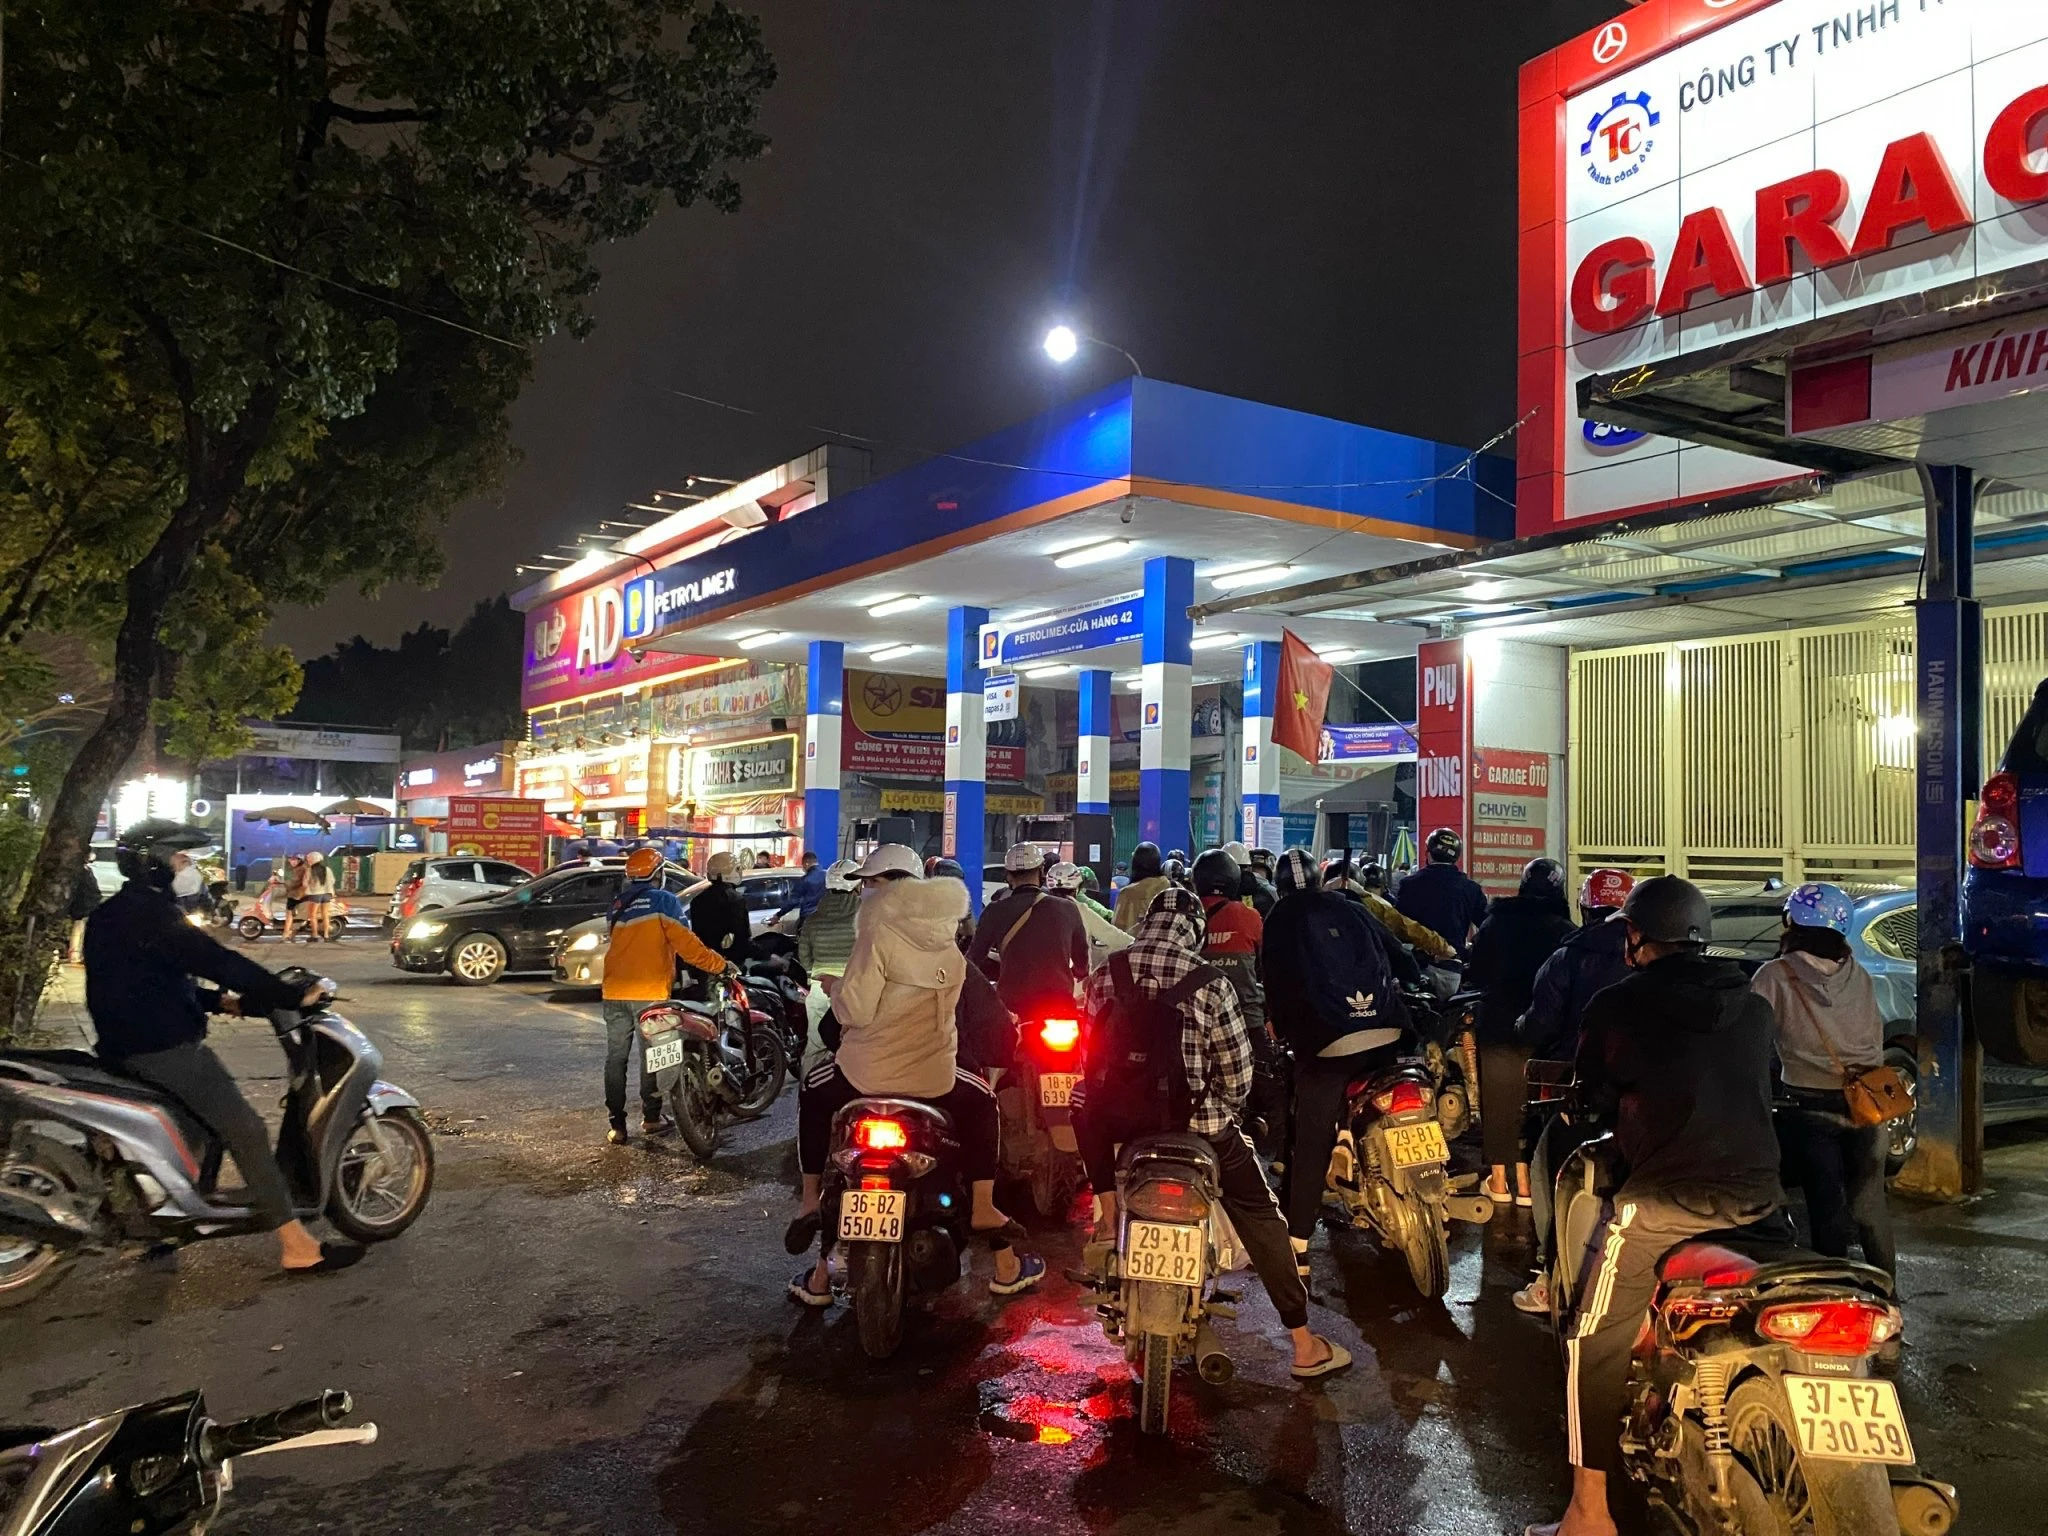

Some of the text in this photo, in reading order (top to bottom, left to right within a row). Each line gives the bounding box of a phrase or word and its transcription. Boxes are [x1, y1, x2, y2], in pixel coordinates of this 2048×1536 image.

[1679, 0, 1899, 112] CÔNG TY TNHH
[655, 568, 736, 615] PETROLIMEX
[1015, 618, 1089, 645] PETROLIMEX-CỬA
[1091, 614, 1118, 631] HÀNG
[1120, 611, 1132, 624] 42
[1424, 664, 1457, 712] PHỤ
[855, 741, 882, 752] CÔNG
[884, 744, 898, 754] TY
[902, 745, 931, 755] TNHH
[743, 759, 786, 779] SUZUKI
[1419, 750, 1461, 797] TÙNG
[1488, 760, 1547, 787] GARAGE ÔTÔ
[1478, 802, 1526, 818] CHUYÊN
[1349, 1009, 1377, 1018] adidas
[652, 1043, 677, 1058] 18-B2
[1393, 1126, 1434, 1147] 29-B1
[1395, 1142, 1445, 1164] 415.62
[851, 1194, 896, 1215] 36-B2
[843, 1216, 899, 1238] 550.48
[1139, 1225, 1191, 1253] 29-X1
[1131, 1251, 1197, 1280] 582.82
[1814, 1362, 1851, 1372] HONDA
[1801, 1382, 1885, 1419] 37-F2
[1801, 1418, 1905, 1457] 730.59
